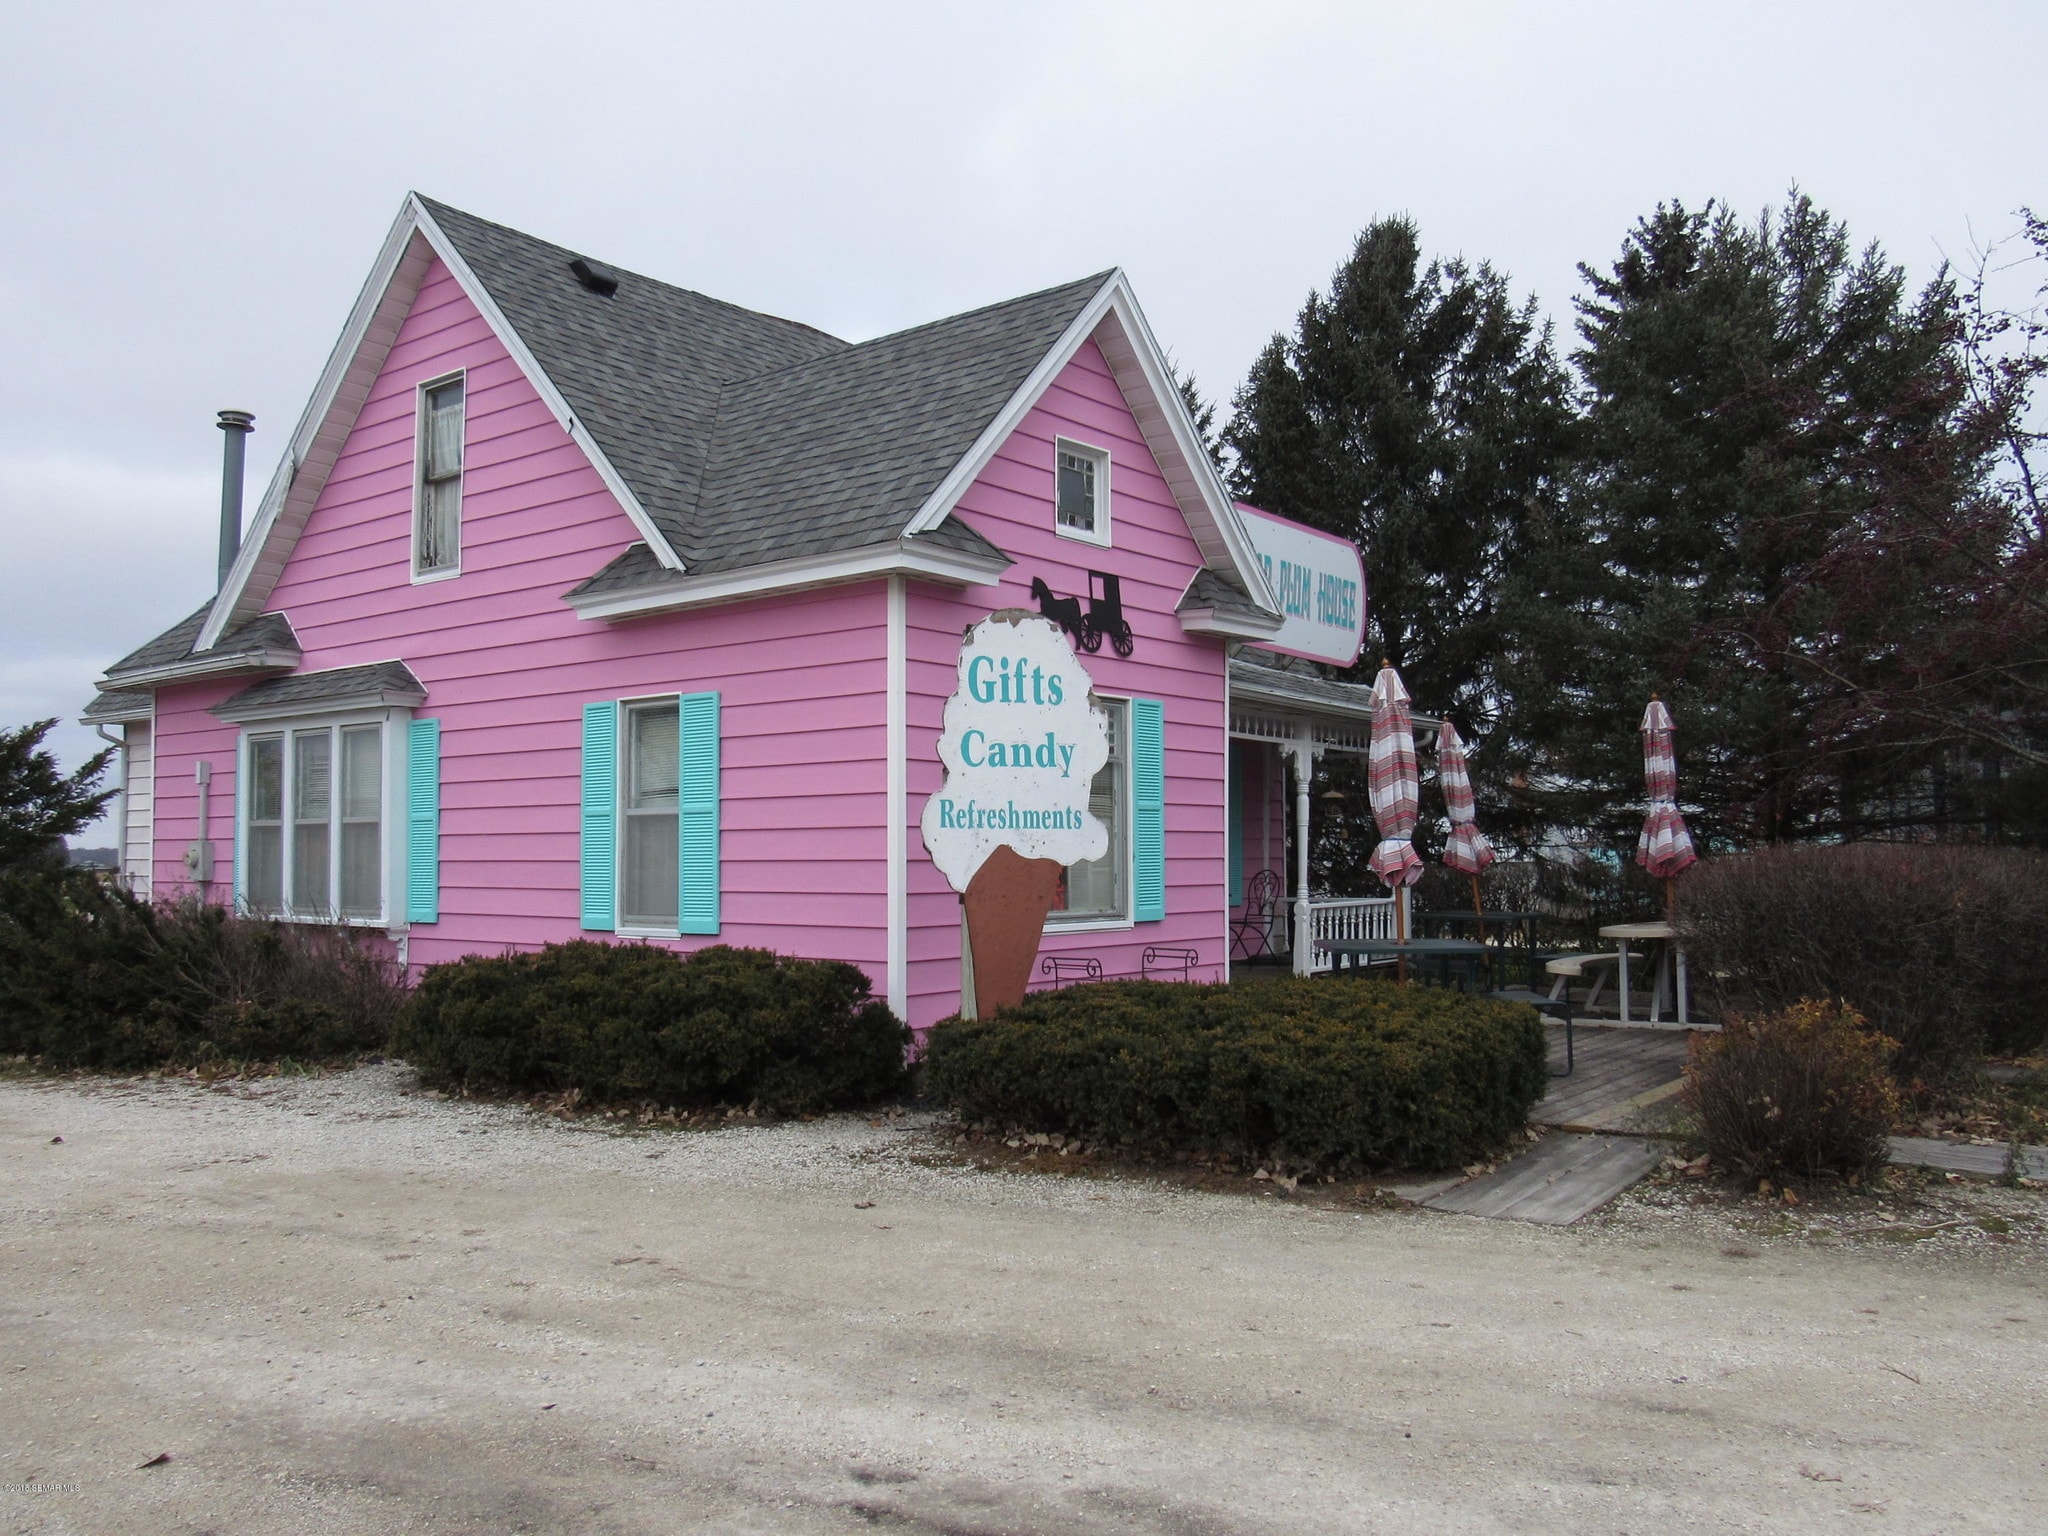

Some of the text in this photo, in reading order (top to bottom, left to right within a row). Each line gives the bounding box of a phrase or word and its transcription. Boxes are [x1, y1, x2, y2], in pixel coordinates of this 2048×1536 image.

[1279, 560, 1312, 619] PLUM
[1317, 572, 1356, 631] HOUSE
[968, 655, 1063, 706] Gifts
[960, 730, 1075, 777] Candy
[939, 799, 1082, 830] Refreshments
